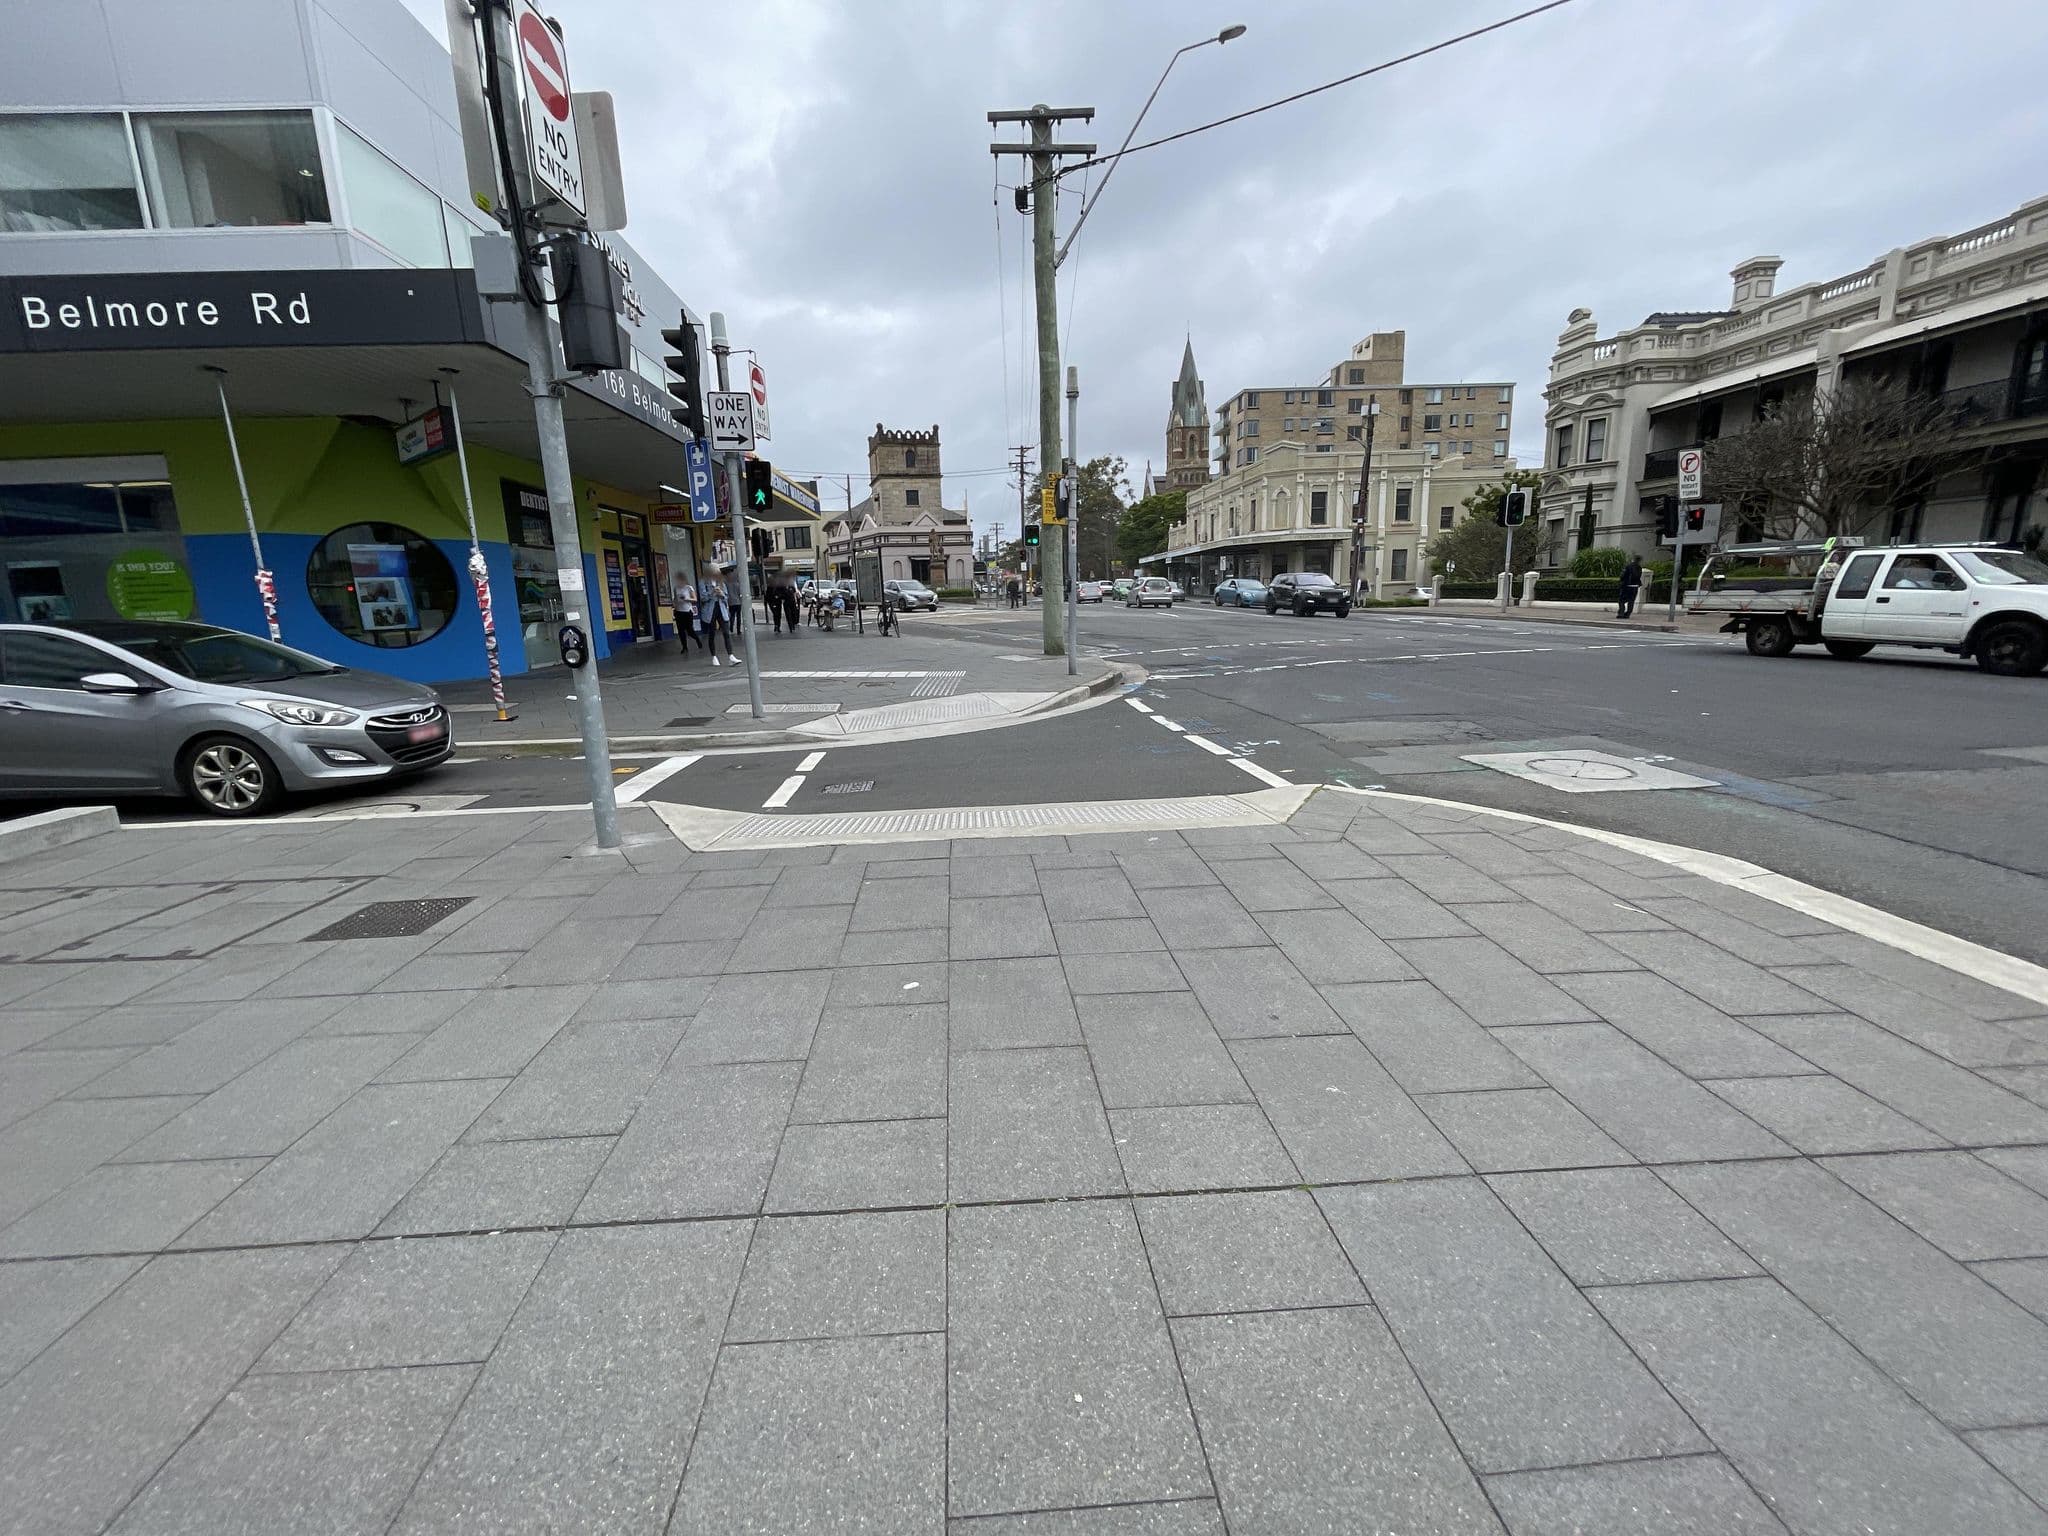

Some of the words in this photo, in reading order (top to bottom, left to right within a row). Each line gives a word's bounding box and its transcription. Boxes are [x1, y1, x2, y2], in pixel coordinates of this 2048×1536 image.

[543, 116, 568, 161] NO
[538, 145, 578, 199] ENTRY
[22, 296, 219, 329] Belmore
[250, 292, 311, 325] Rd
[602, 369, 626, 398] 168
[632, 383, 678, 429] Belmore
[715, 398, 745, 411] ONE
[714, 415, 747, 430] WAY
[757, 408, 766, 421] NO
[693, 471, 708, 497] P
[1683, 474, 1696, 482] NO
[519, 491, 548, 512] DENTIST
